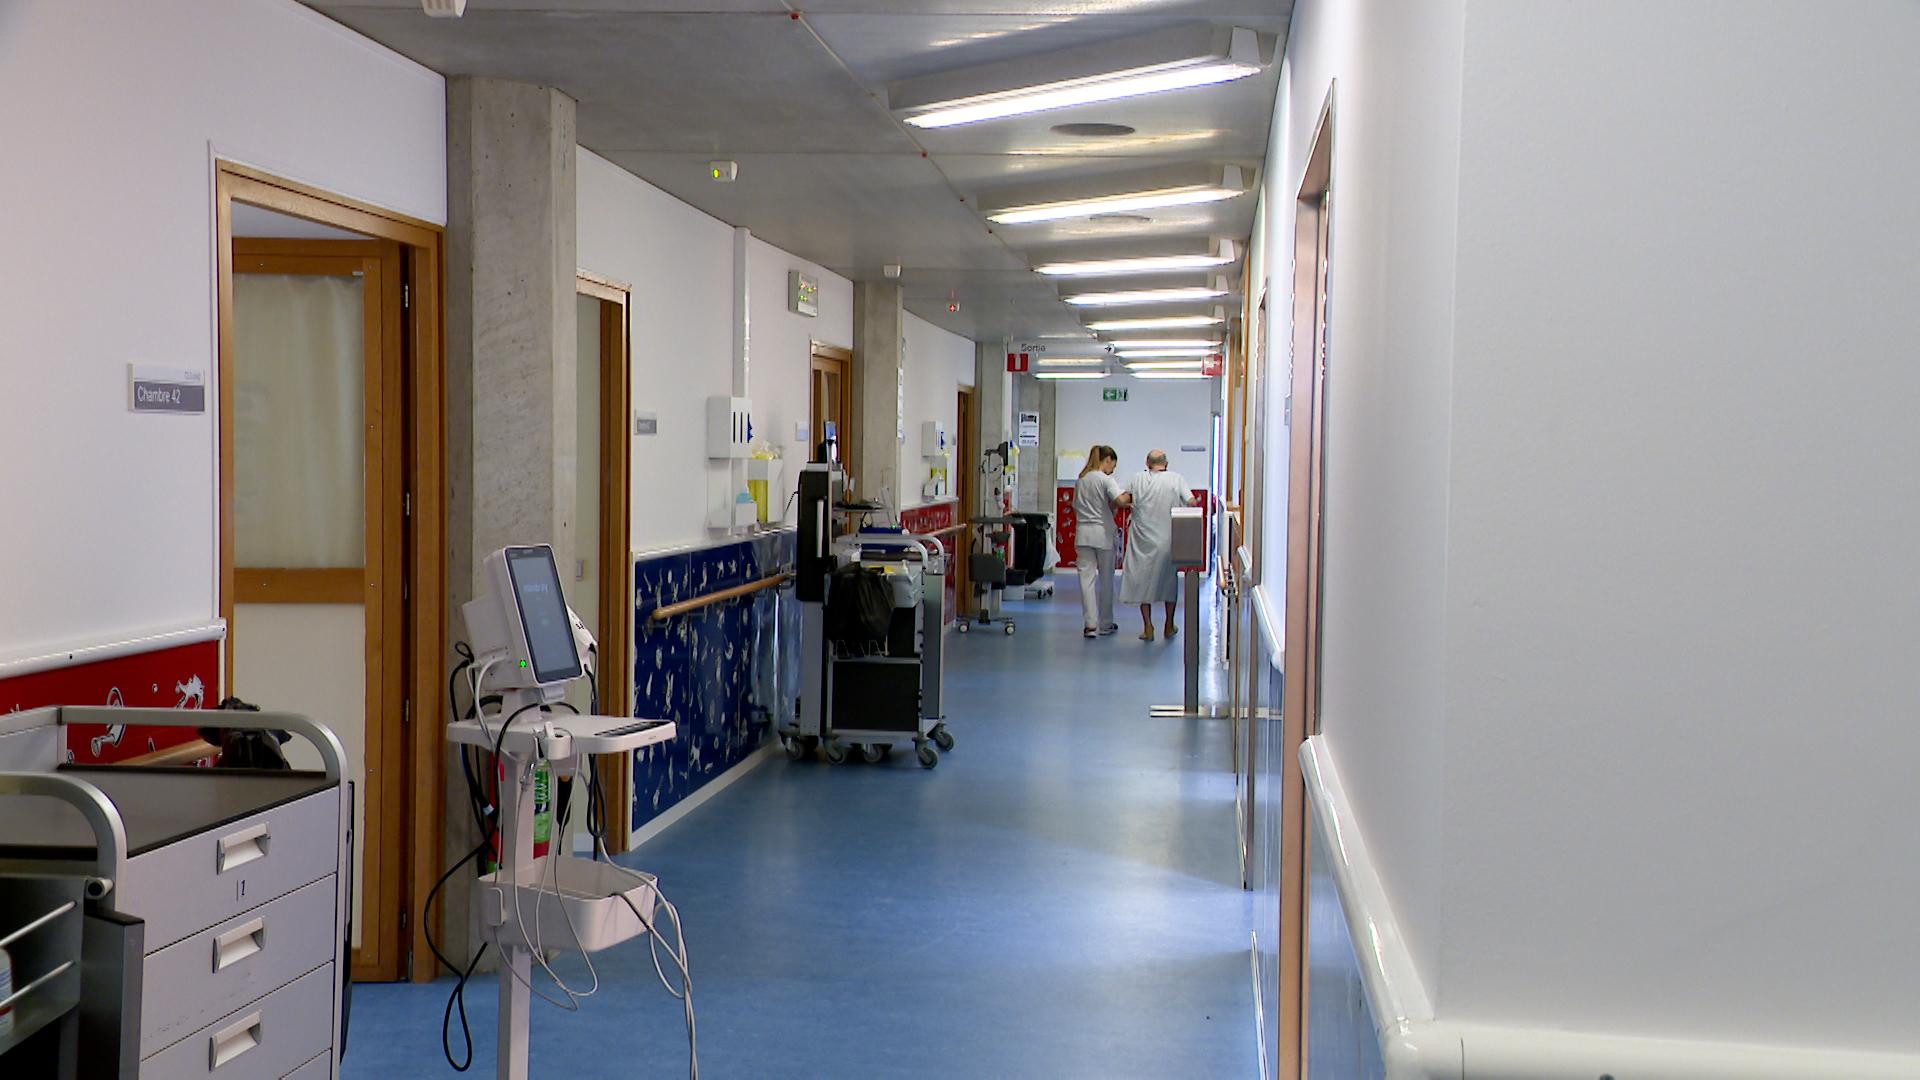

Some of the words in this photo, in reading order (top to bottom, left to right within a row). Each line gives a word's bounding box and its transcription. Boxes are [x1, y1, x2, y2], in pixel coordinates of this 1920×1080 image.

[1021, 343, 1046, 352] Sortie
[137, 385, 171, 403] Chambre
[171, 388, 182, 404] 42
